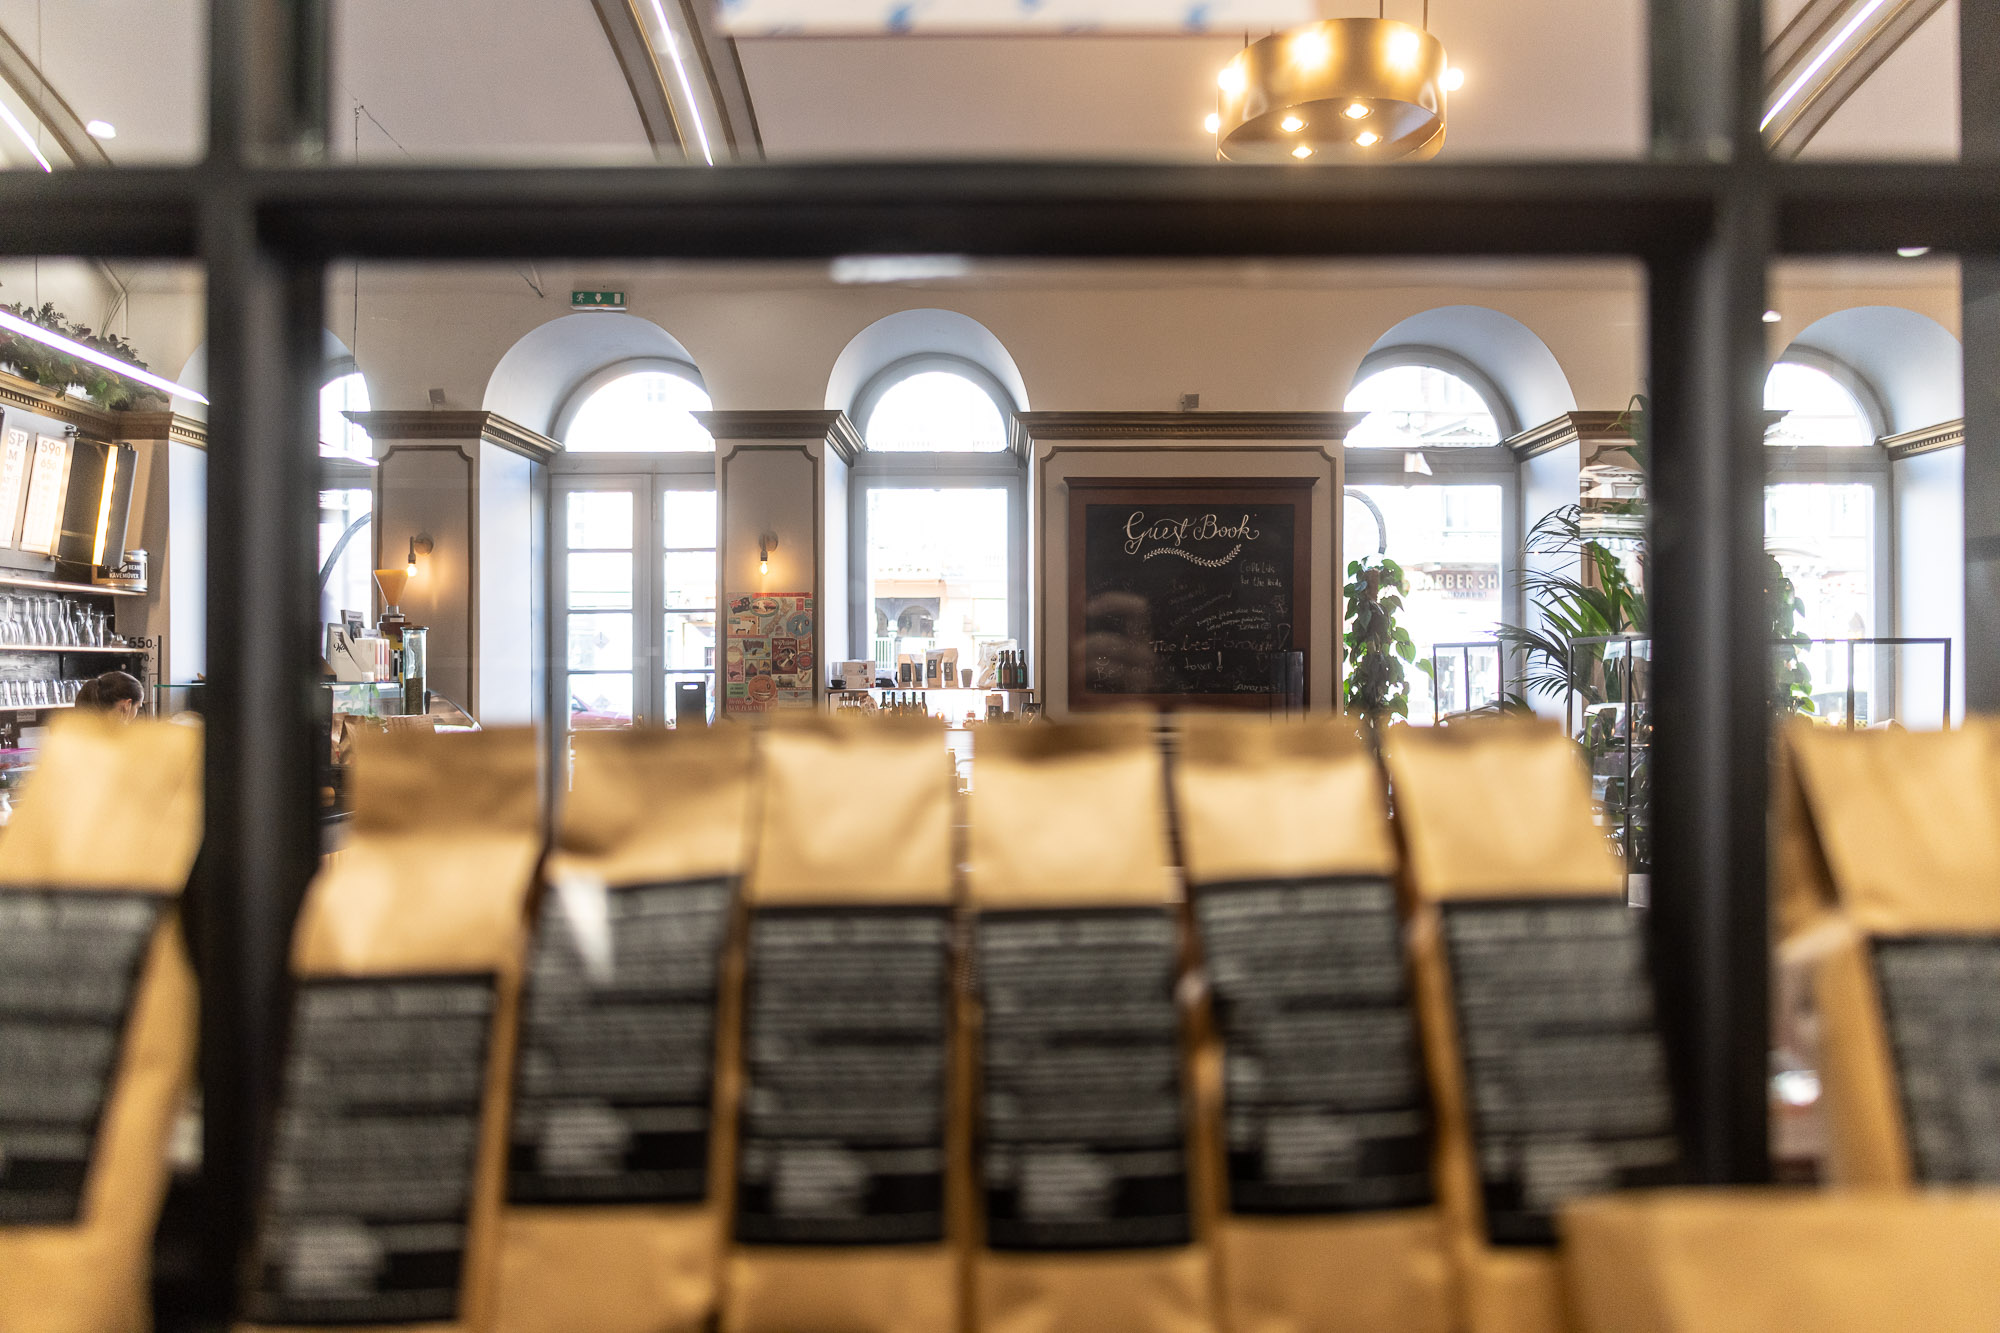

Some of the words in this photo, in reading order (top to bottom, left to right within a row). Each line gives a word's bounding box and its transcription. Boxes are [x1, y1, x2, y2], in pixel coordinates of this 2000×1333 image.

[1123, 511, 1198, 555] Guest
[1193, 513, 1260, 541] Book
[1478, 573, 1498, 590] SH
